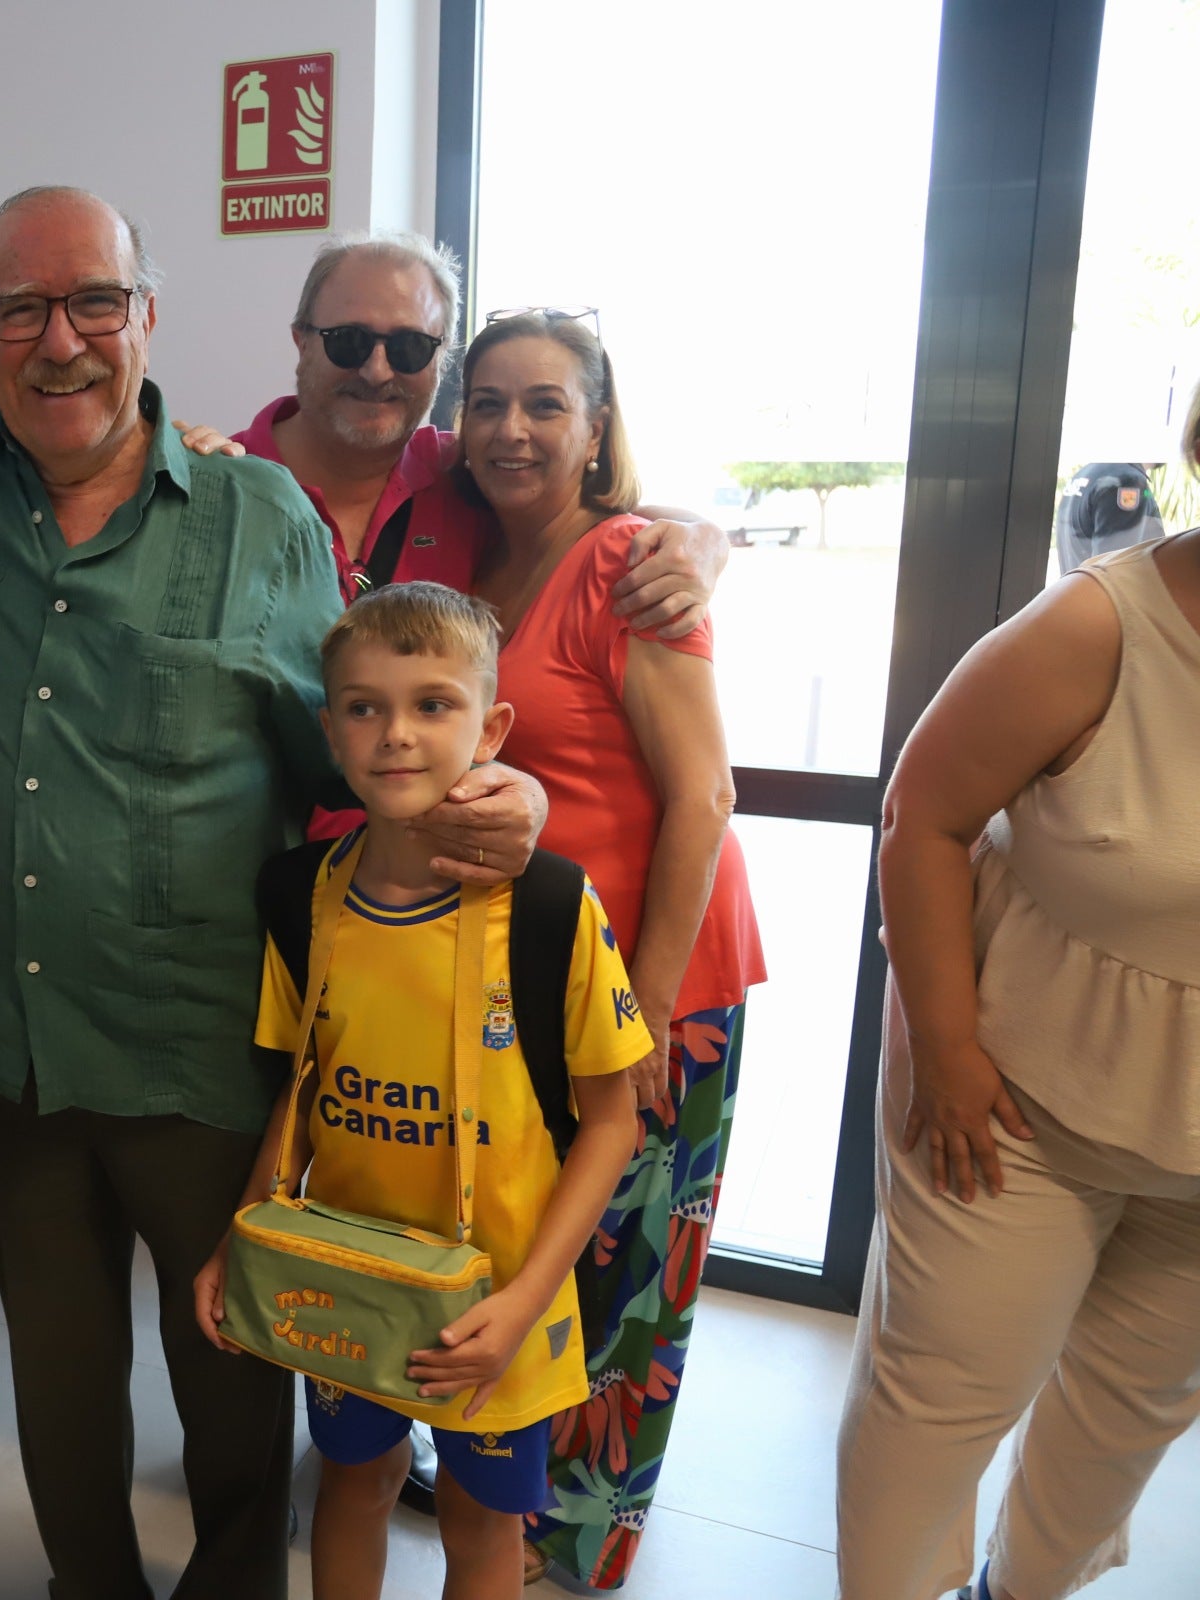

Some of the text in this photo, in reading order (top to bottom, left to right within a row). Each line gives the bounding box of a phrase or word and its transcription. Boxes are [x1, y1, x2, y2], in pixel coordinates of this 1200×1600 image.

[227, 193, 324, 222] EXTINTOR
[335, 1065, 440, 1111] Gran
[274, 1288, 334, 1310] mon
[470, 1441, 513, 1459] hummel
